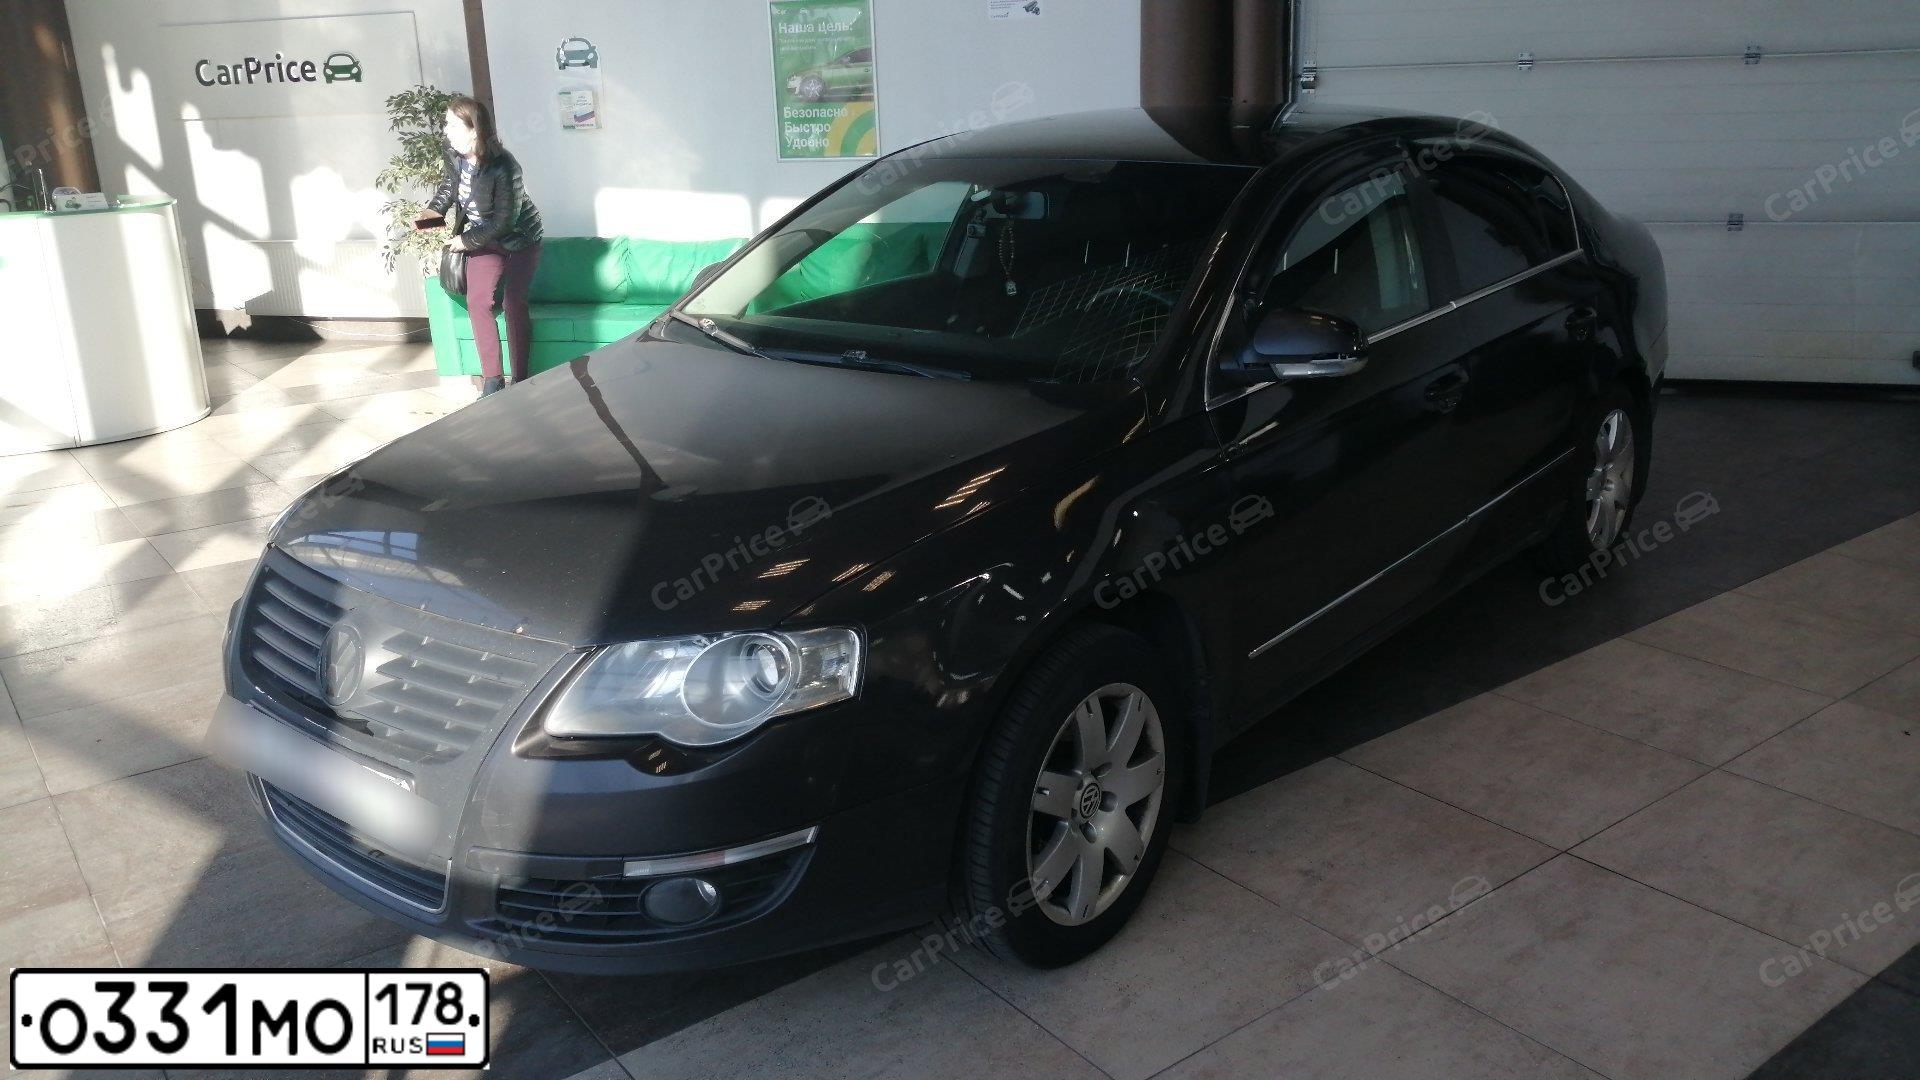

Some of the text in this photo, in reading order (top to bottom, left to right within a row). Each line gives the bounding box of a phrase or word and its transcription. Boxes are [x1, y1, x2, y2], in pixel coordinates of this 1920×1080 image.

[778, 22, 815, 34] Наша
[195, 53, 317, 87] CarPrice
[783, 106, 849, 118] Безопасно
[784, 121, 831, 134] Быстро
[785, 134, 830, 149] Удобно
